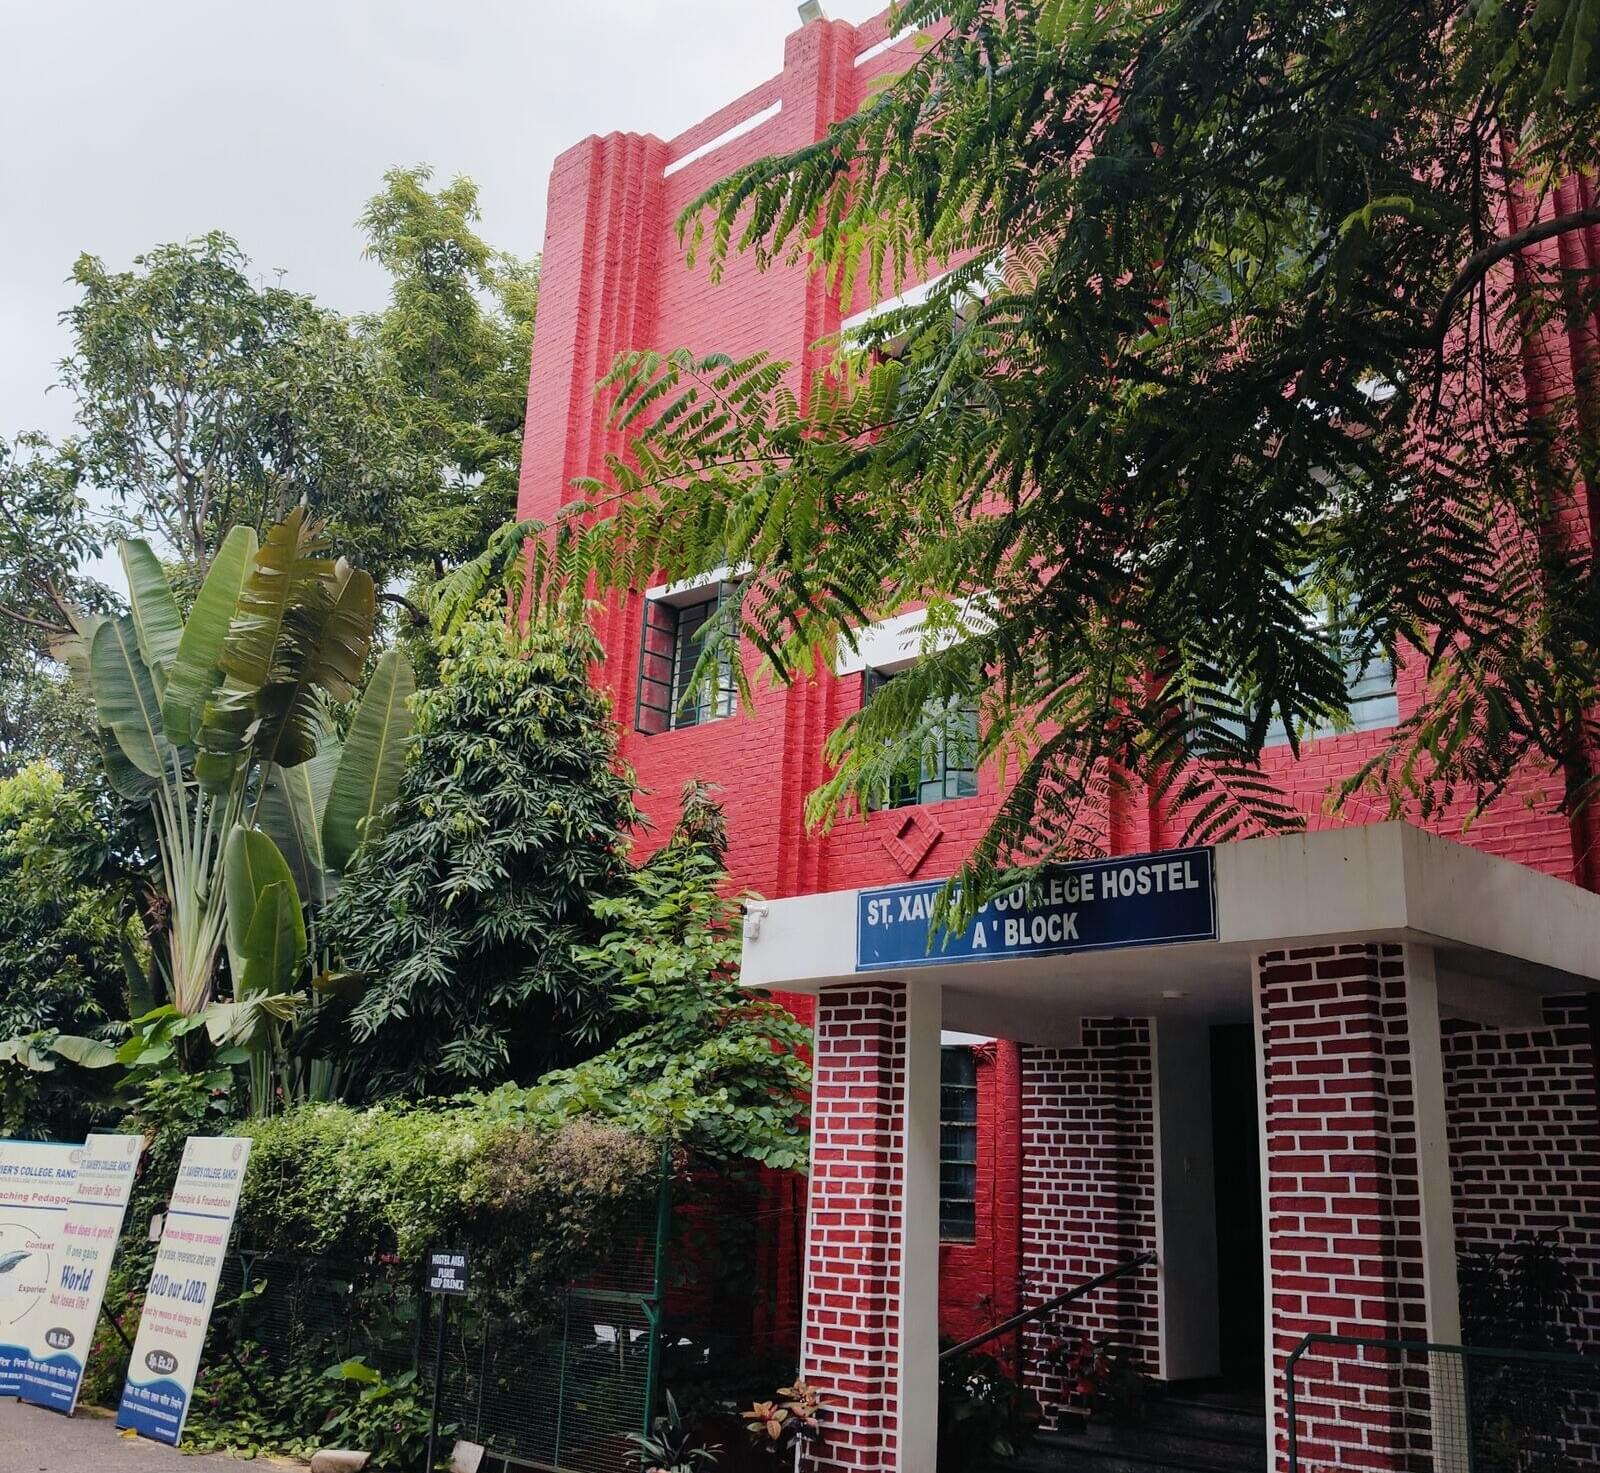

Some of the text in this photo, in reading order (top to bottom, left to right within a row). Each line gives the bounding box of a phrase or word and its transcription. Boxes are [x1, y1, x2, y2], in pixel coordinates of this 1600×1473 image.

[867, 898, 893, 925] ST.
[1102, 861, 1200, 900] HOSTEL
[1005, 912, 1080, 946] BLOCK
[56, 1168, 78, 1178] RANC
[201, 1195, 232, 1208] Foundation
[25, 1240, 55, 1250] Context
[60, 1264, 94, 1292] World
[151, 1274, 168, 1296] GOD
[168, 1281, 182, 1299] our
